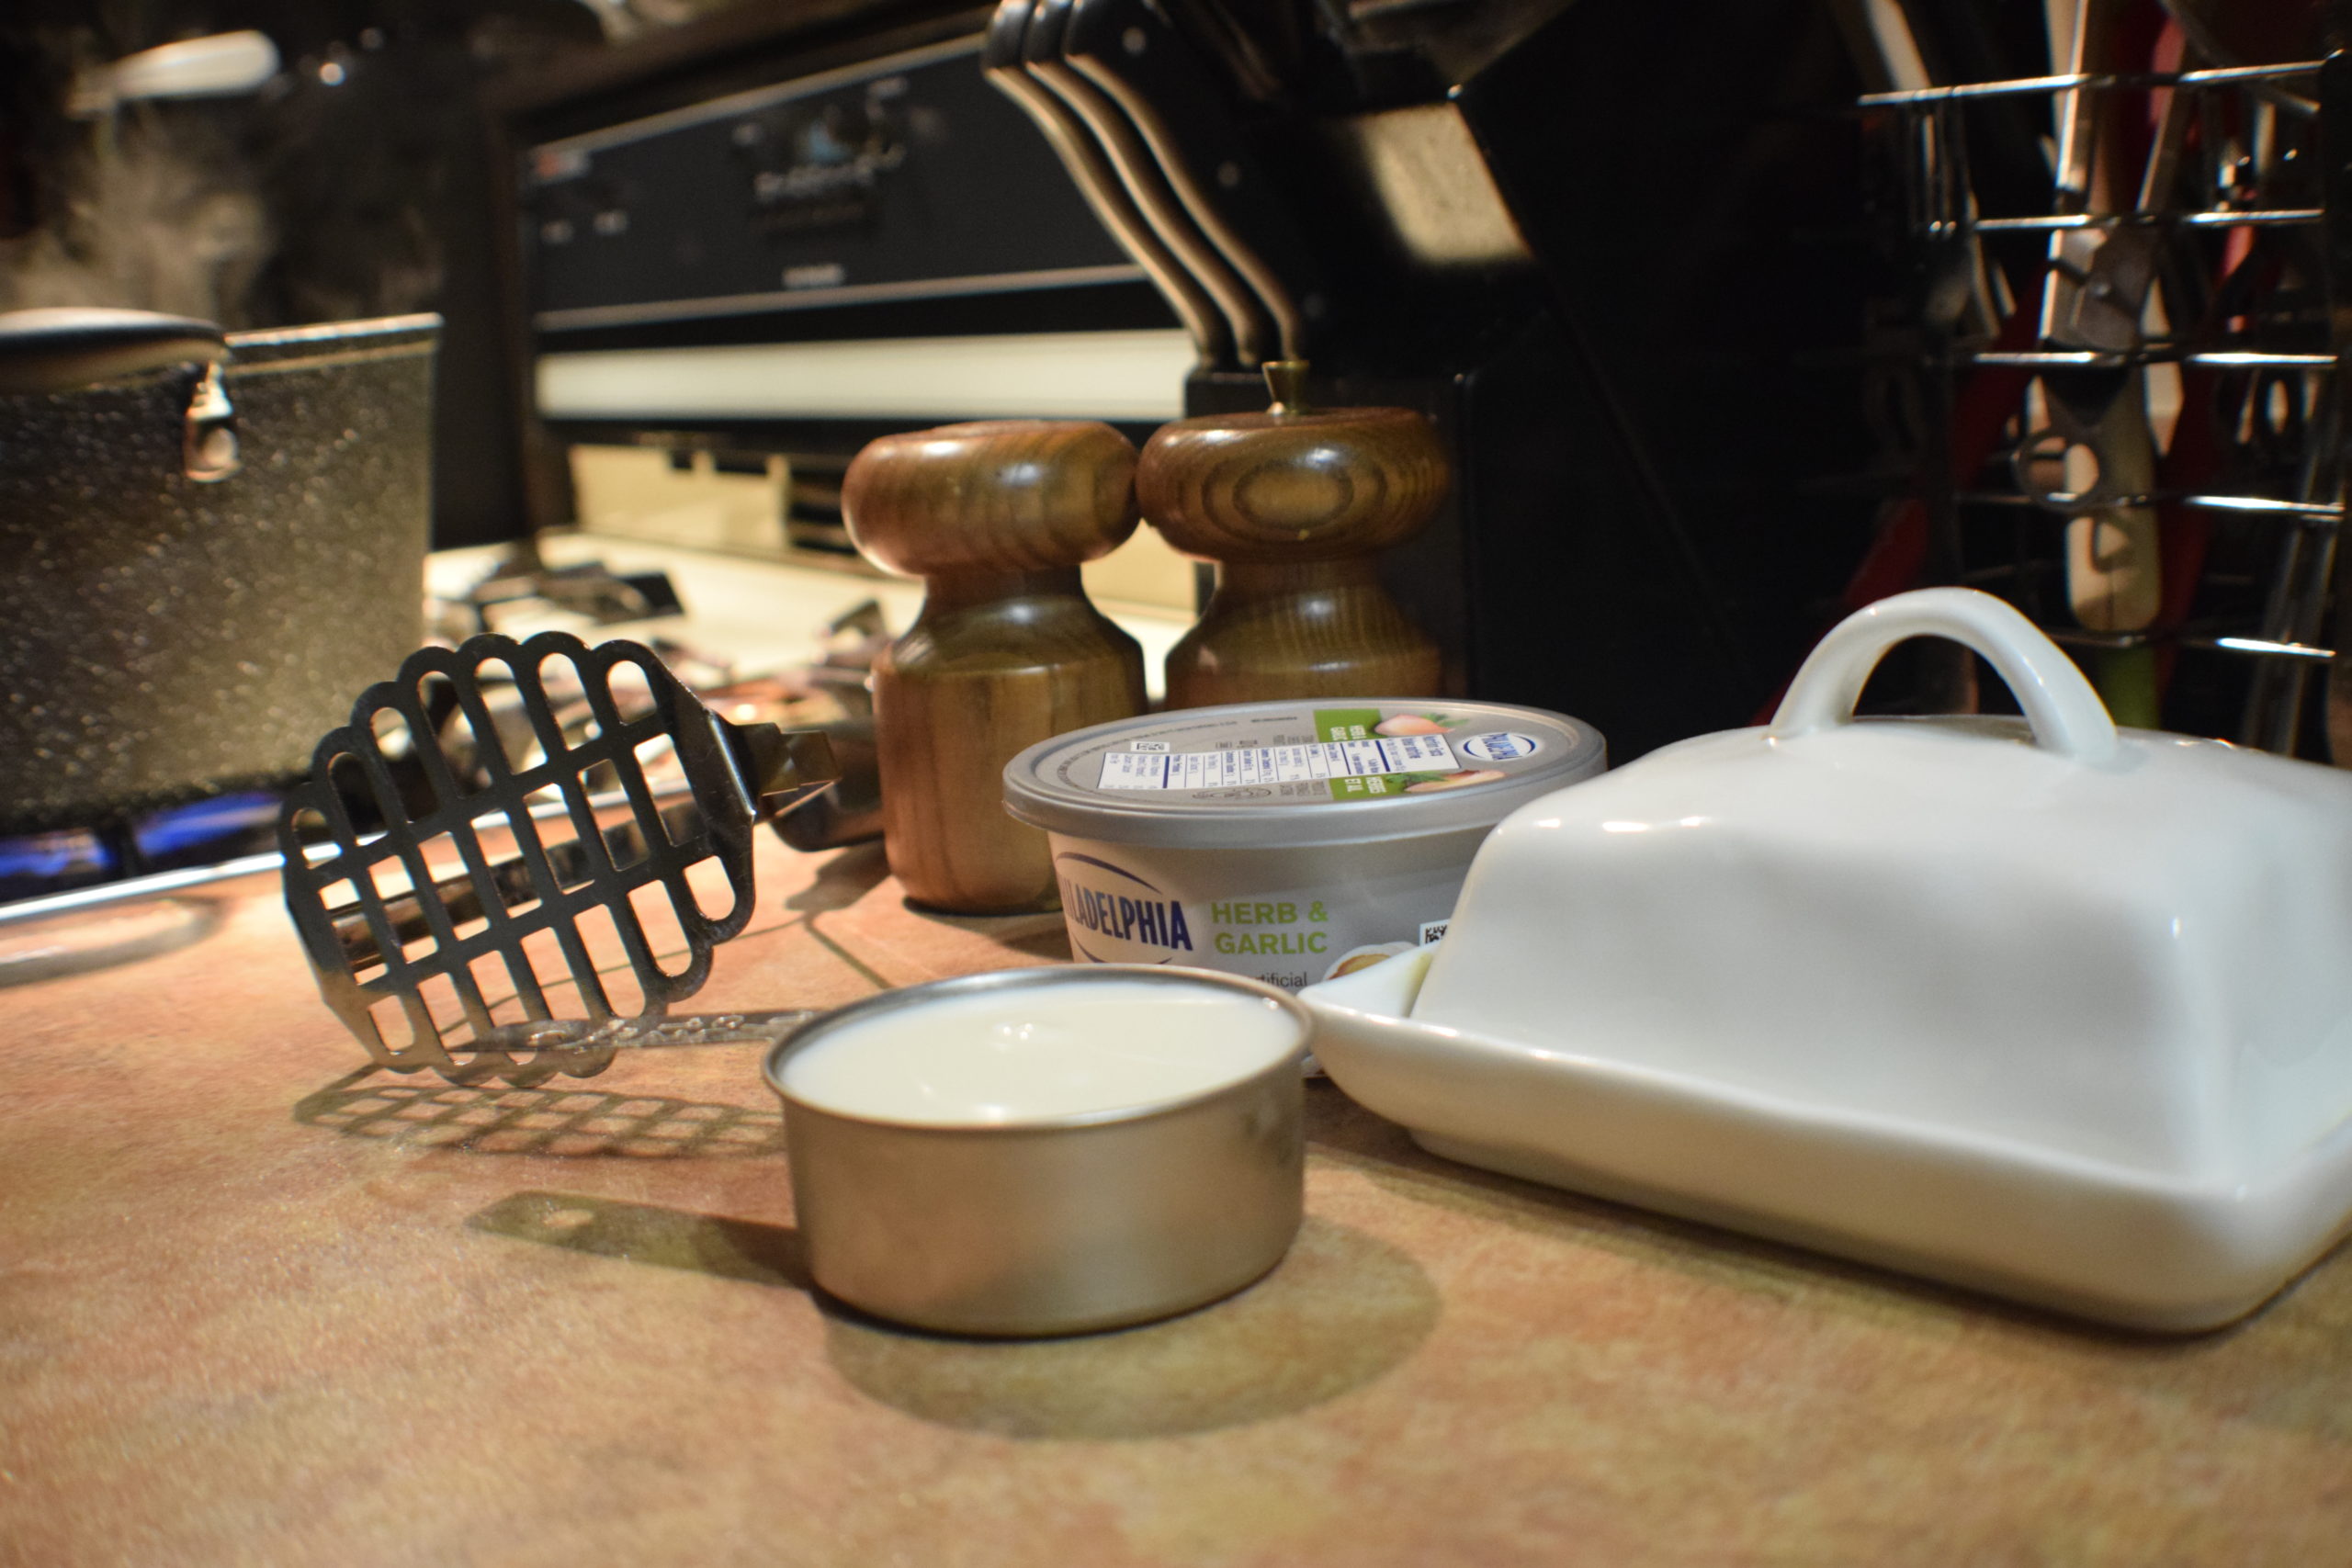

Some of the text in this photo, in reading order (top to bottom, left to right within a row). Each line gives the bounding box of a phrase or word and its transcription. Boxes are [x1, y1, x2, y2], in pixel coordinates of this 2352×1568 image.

[1212, 900, 1329, 924] HERB &
[1215, 932, 1328, 955] GARLIC
[1258, 971, 1307, 987] tificial
